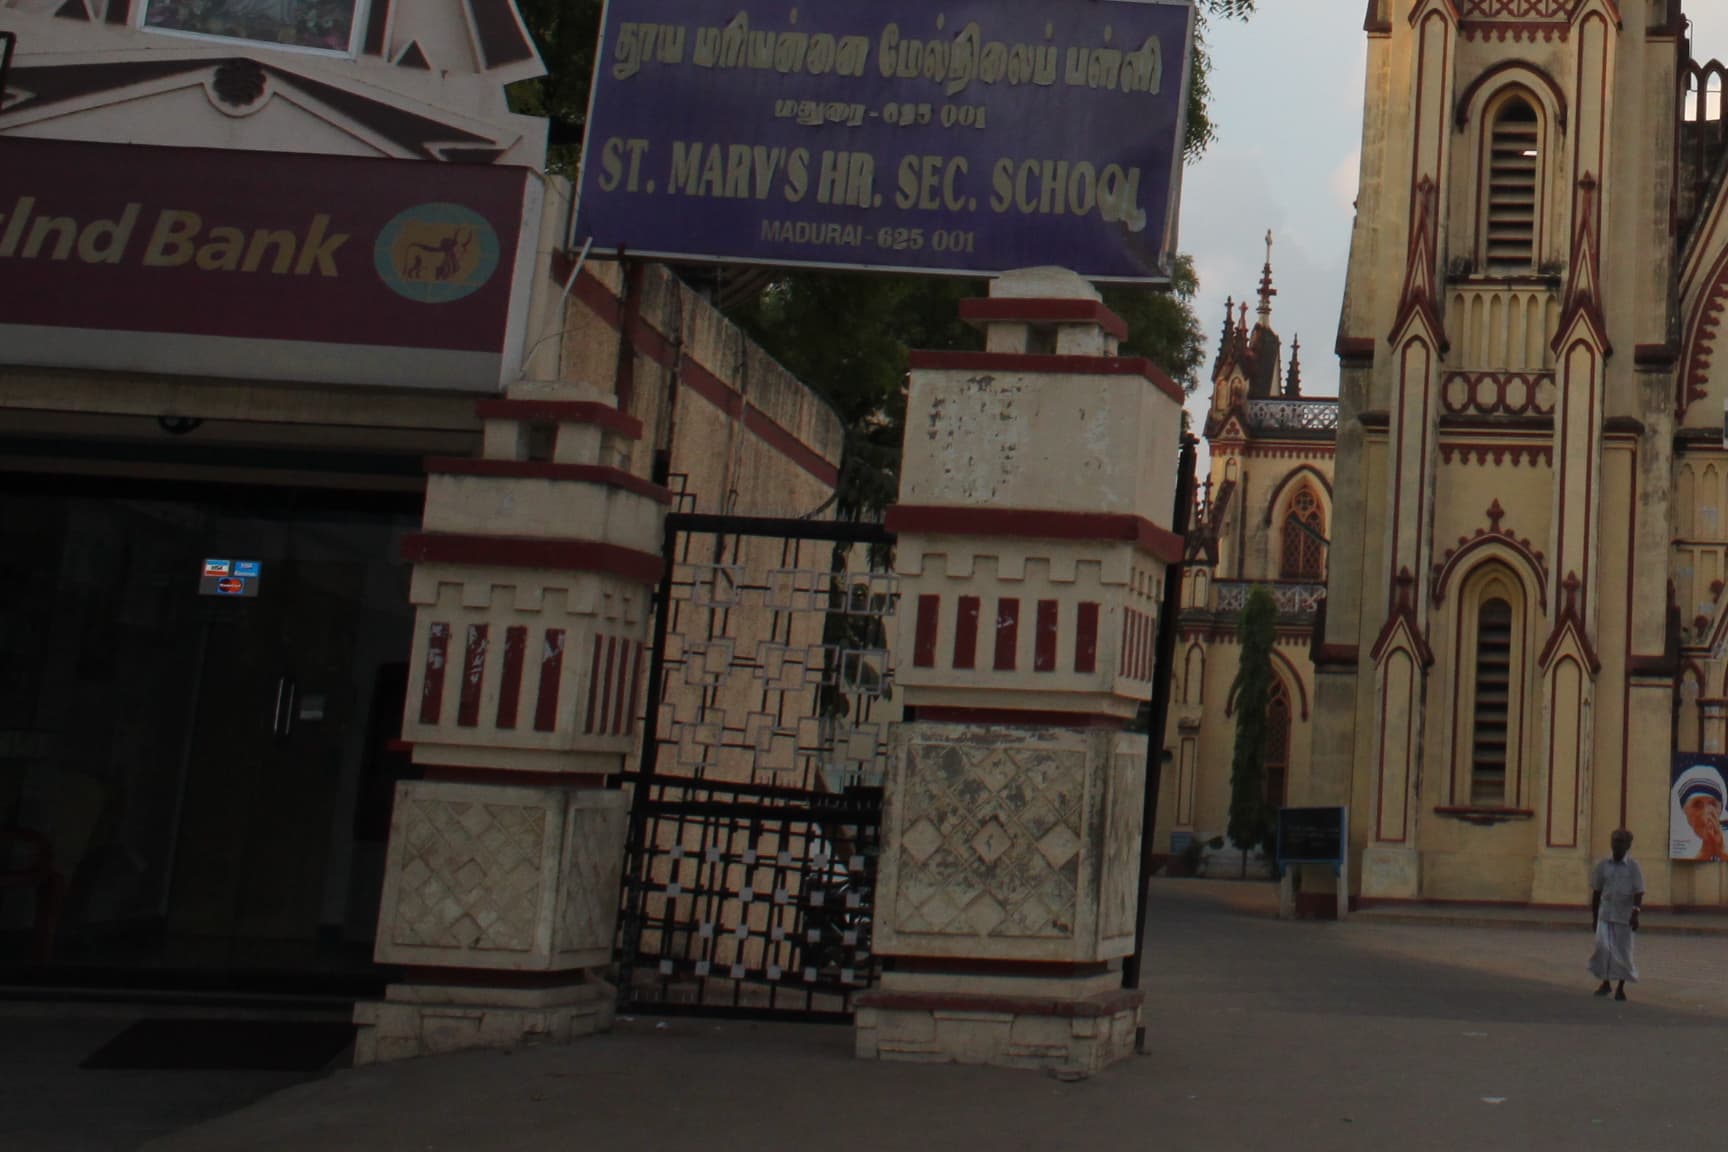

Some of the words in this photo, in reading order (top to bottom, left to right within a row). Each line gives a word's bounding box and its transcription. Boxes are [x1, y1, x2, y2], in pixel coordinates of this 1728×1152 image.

[693, 6, 869, 77] மரியன்னை
[1064, 24, 1162, 95] பள்ளி
[940, 103, 987, 129] 001
[597, 136, 656, 194] ST.
[667, 141, 811, 203] MARY'S
[816, 149, 883, 208] HR.
[896, 153, 977, 212] SEC.
[990, 157, 1147, 232] SCHOOL
[0, 196, 143, 264] Ind
[141, 208, 351, 278] Bank
[931, 228, 976, 253] 001
